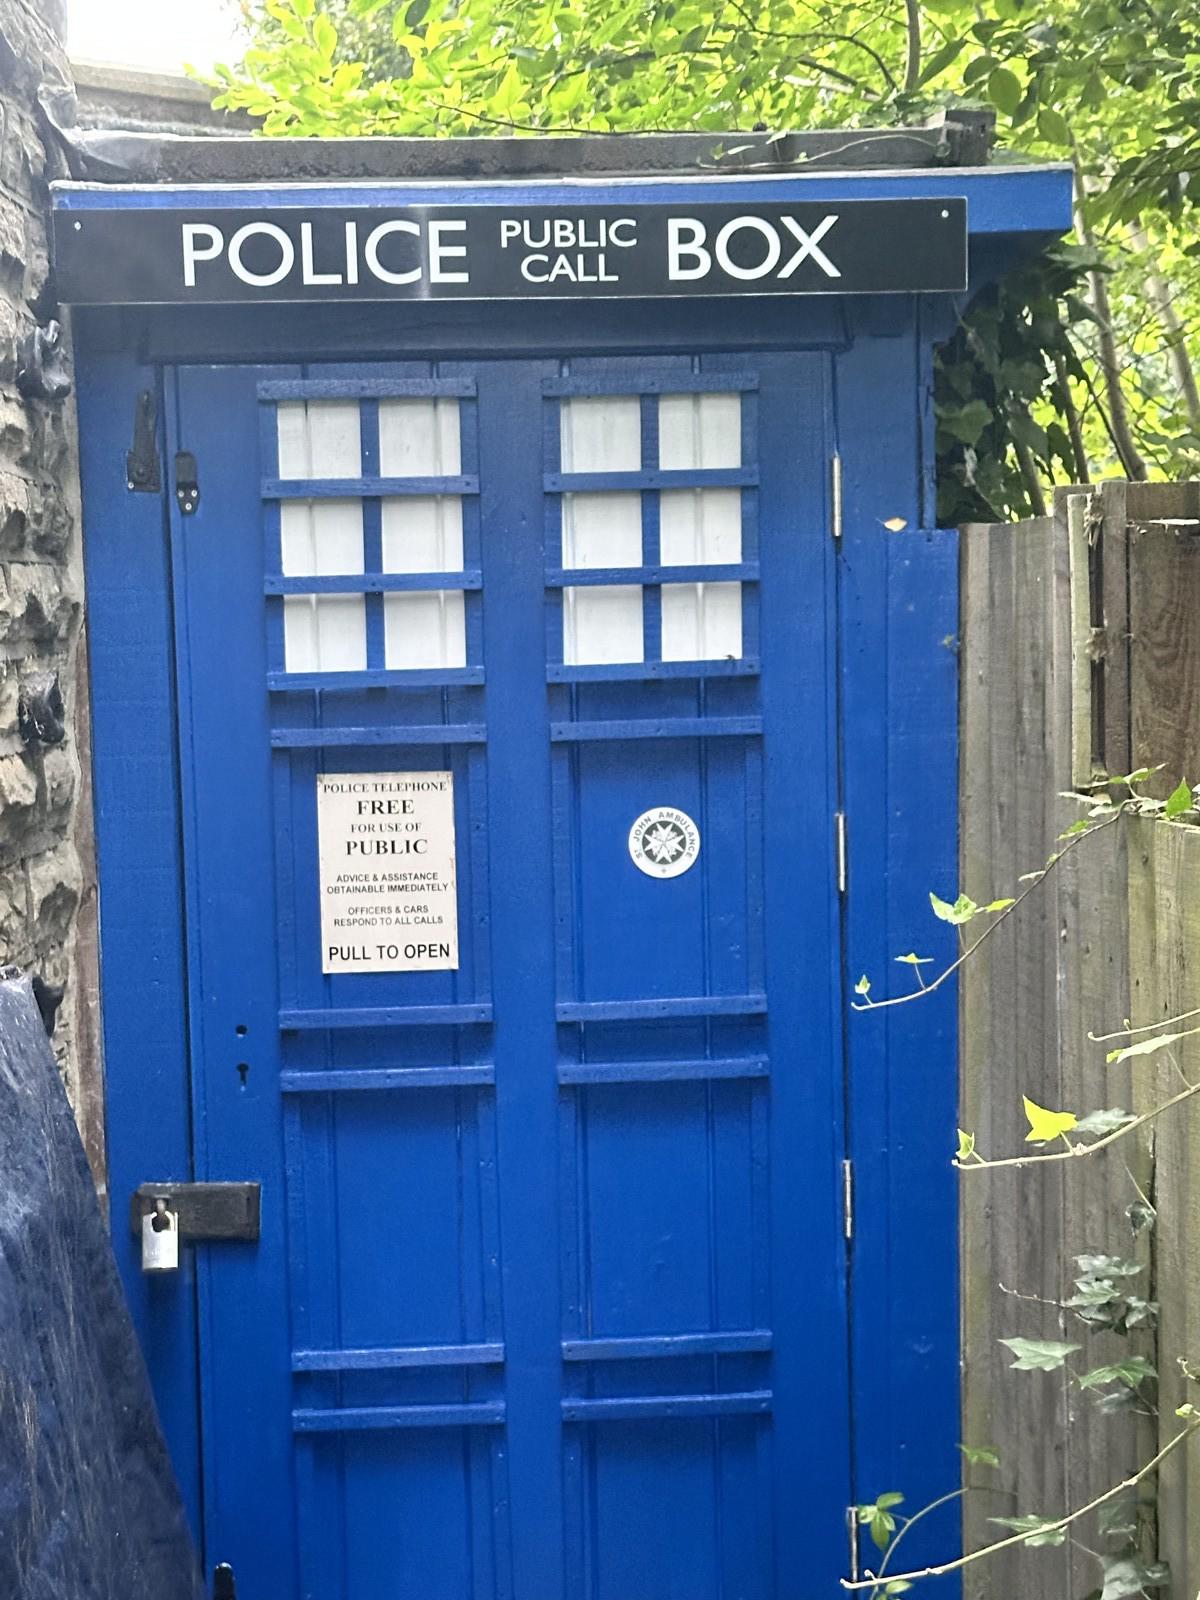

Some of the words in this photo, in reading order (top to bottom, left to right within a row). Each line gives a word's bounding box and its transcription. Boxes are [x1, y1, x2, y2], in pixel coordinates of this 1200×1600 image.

[500, 219, 637, 248] PUBLIC
[182, 220, 469, 287] POLICE
[667, 215, 841, 280] BOX
[520, 254, 619, 283] CALL
[323, 783, 369, 793] POLICE
[372, 781, 447, 792] TELEPHONE
[357, 799, 415, 815] FREE
[351, 823, 376, 833] FOR
[379, 823, 402, 833] USE
[405, 822, 422, 832] OF
[633, 815, 652, 842] JOHN
[658, 811, 696, 858] AMBULANCE
[346, 839, 428, 856] PUBLIC
[336, 873, 370, 883] ADVICE
[372, 873, 379, 882] &
[381, 872, 439, 882] ASSISTANCE
[327, 884, 385, 894] OBTAINABLE
[387, 883, 448, 893] IMMEDIATELY
[348, 906, 393, 915] OFFICERS
[395, 905, 401, 914] &
[404, 905, 429, 914] CARS
[334, 918, 378, 927] RESPOND
[380, 917, 392, 926] TO
[394, 916, 412, 925] ALL
[414, 915, 443, 925] CALLS
[329, 946, 371, 961] PULL
[376, 945, 399, 960] TO
[404, 943, 450, 959] OPEN
